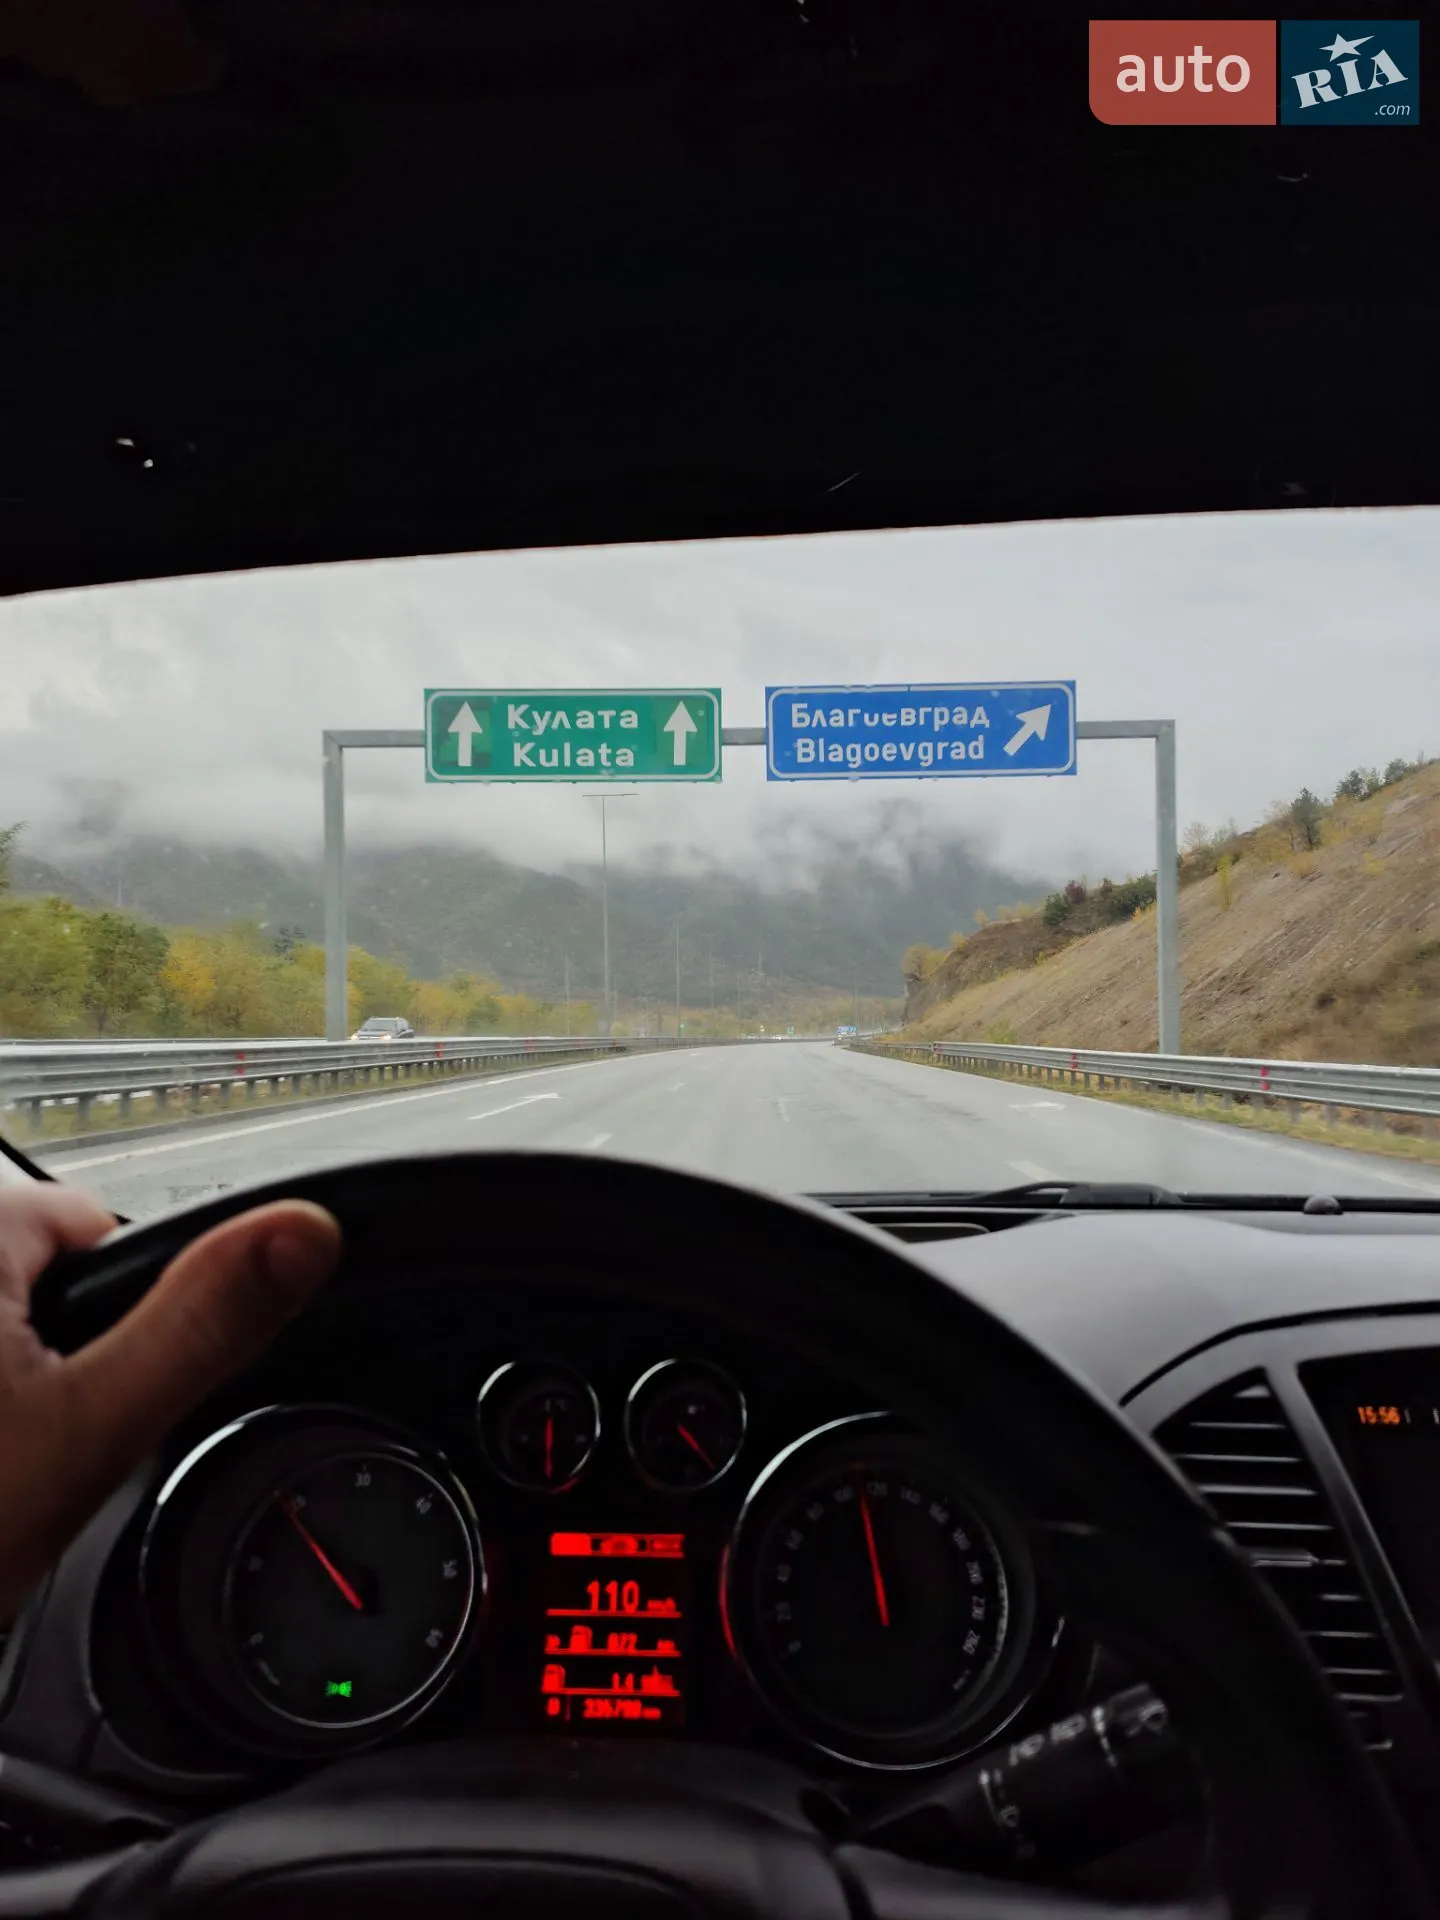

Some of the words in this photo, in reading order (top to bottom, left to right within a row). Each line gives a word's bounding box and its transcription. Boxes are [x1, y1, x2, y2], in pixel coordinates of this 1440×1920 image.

[507, 703, 639, 736] Кулата
[512, 741, 635, 768] Kulata
[796, 733, 985, 769] Blagoevgrad
[586, 1579, 640, 1614] 110
